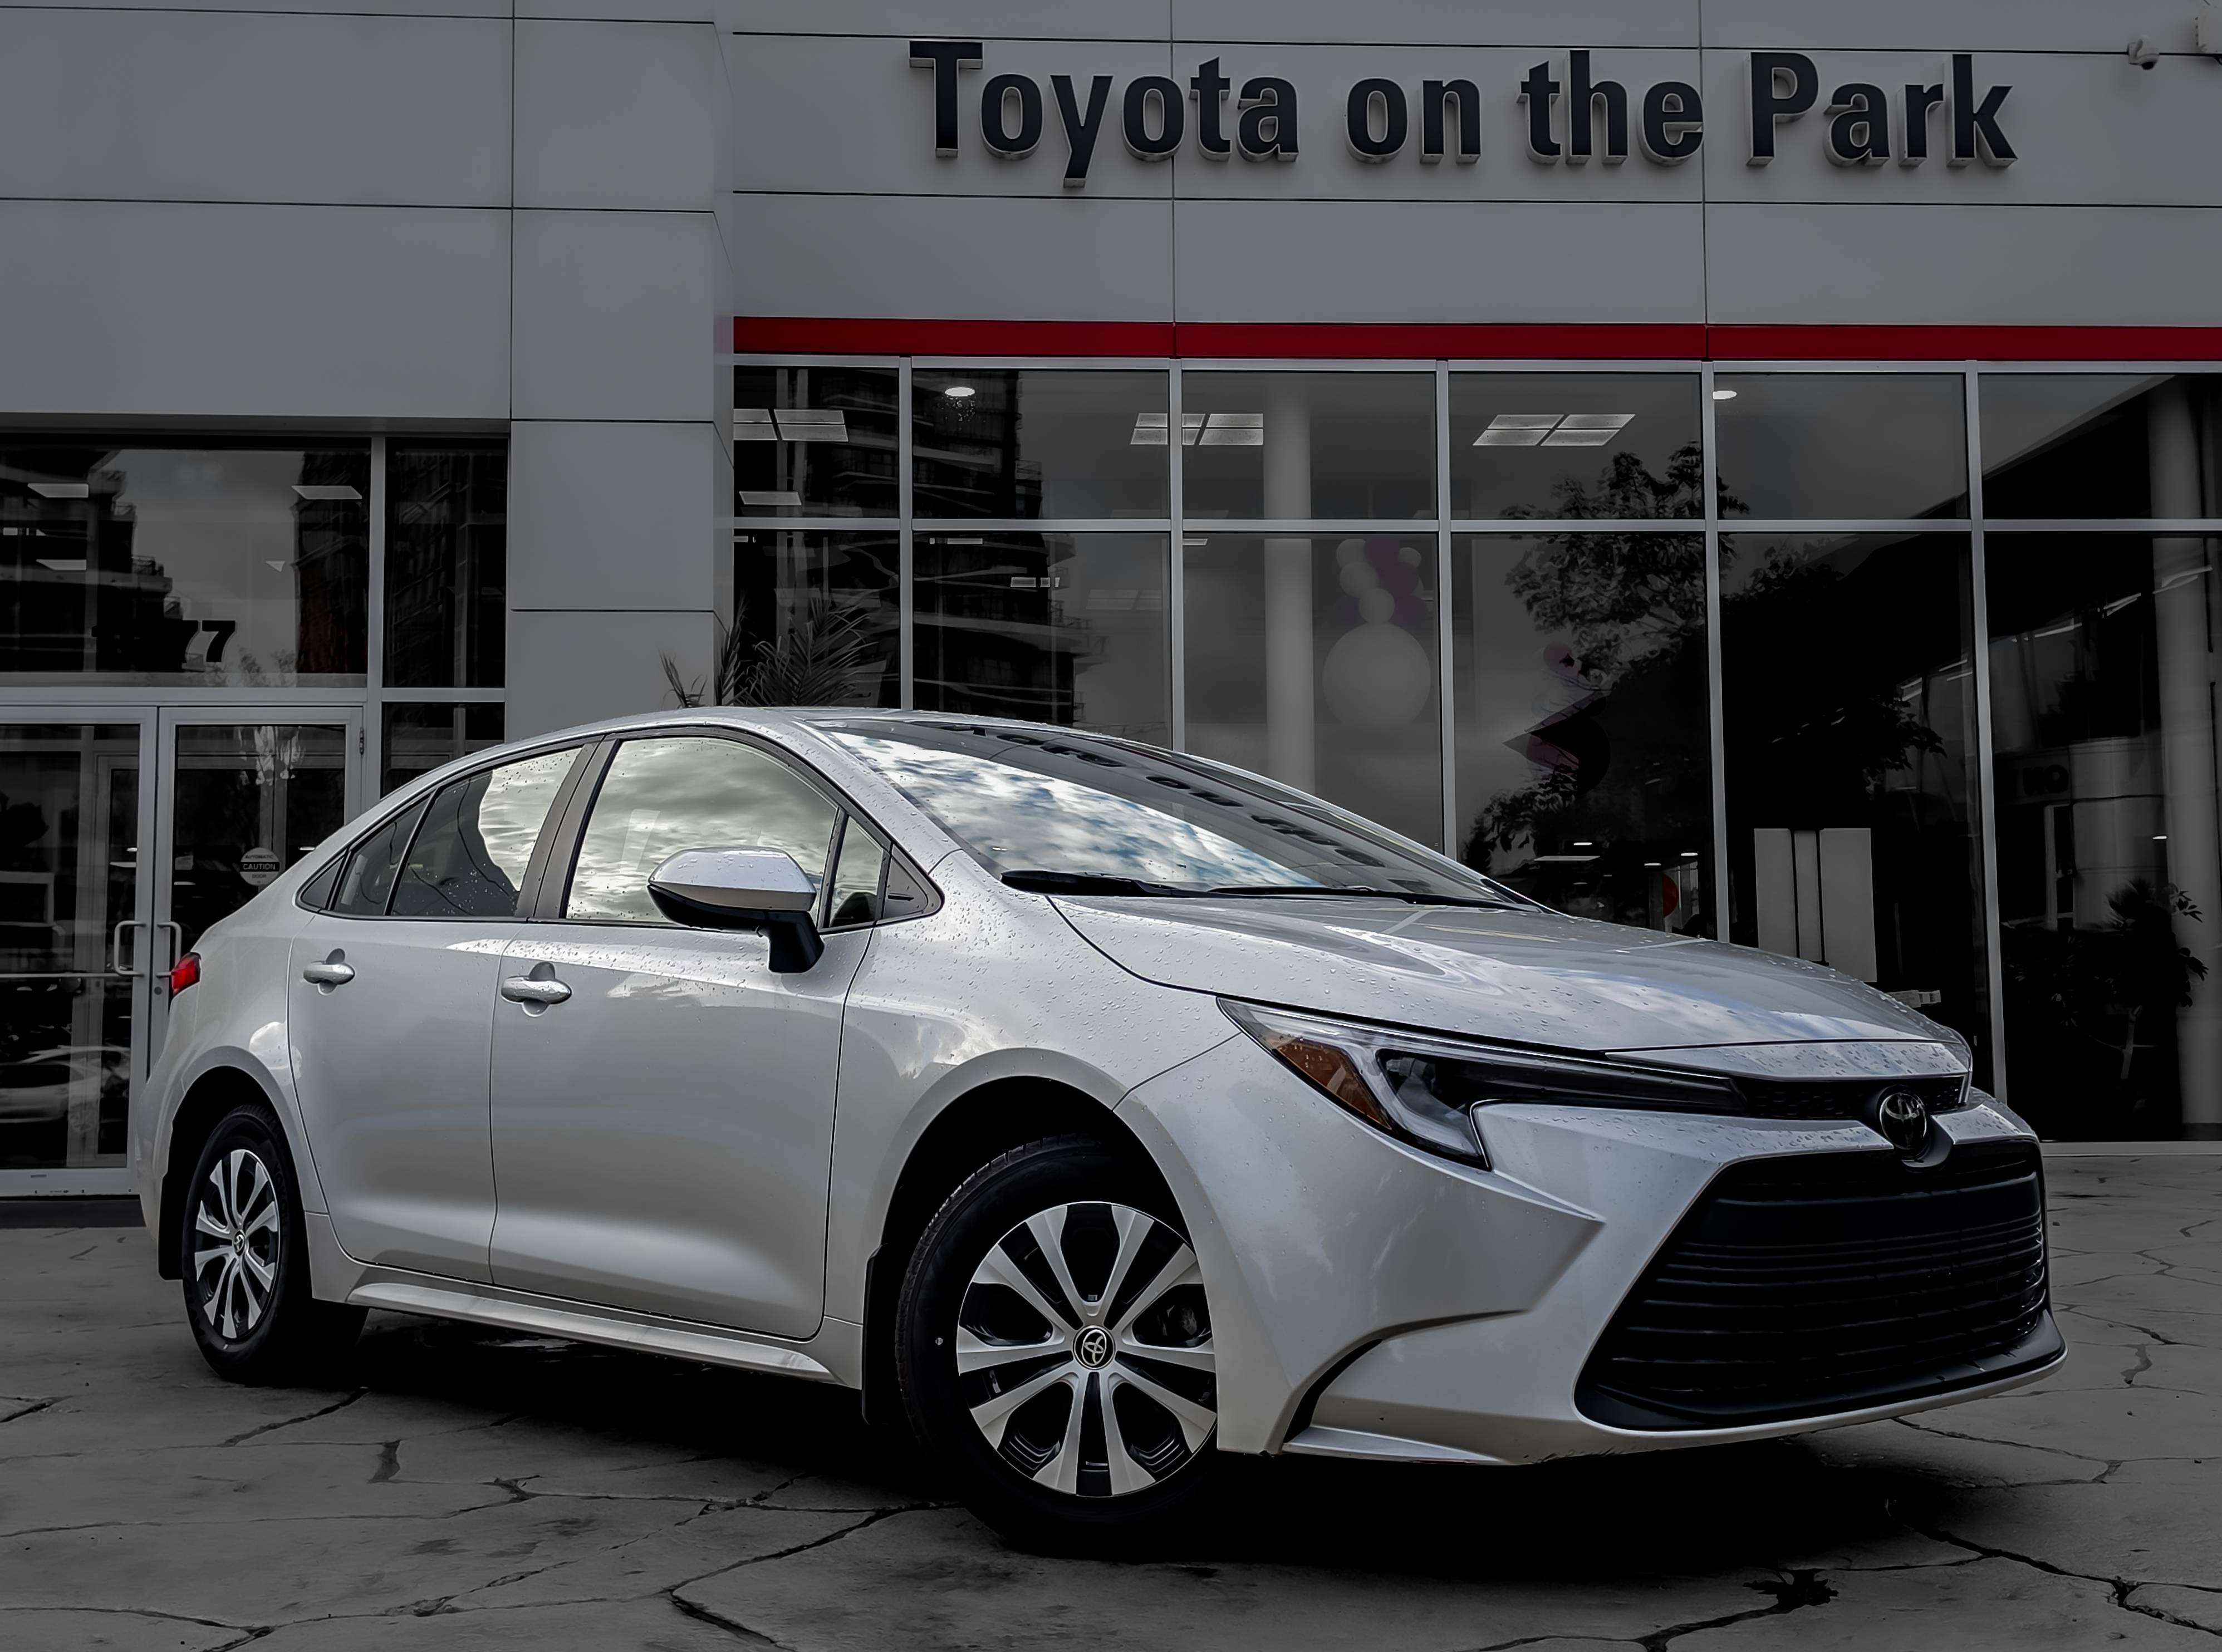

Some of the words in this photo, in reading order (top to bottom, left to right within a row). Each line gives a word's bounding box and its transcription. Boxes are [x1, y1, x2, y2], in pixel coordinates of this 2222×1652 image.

[909, 40, 1299, 188] Toyota
[1345, 77, 1480, 165] on
[1515, 50, 1704, 166] the
[1745, 51, 2019, 168] Park
